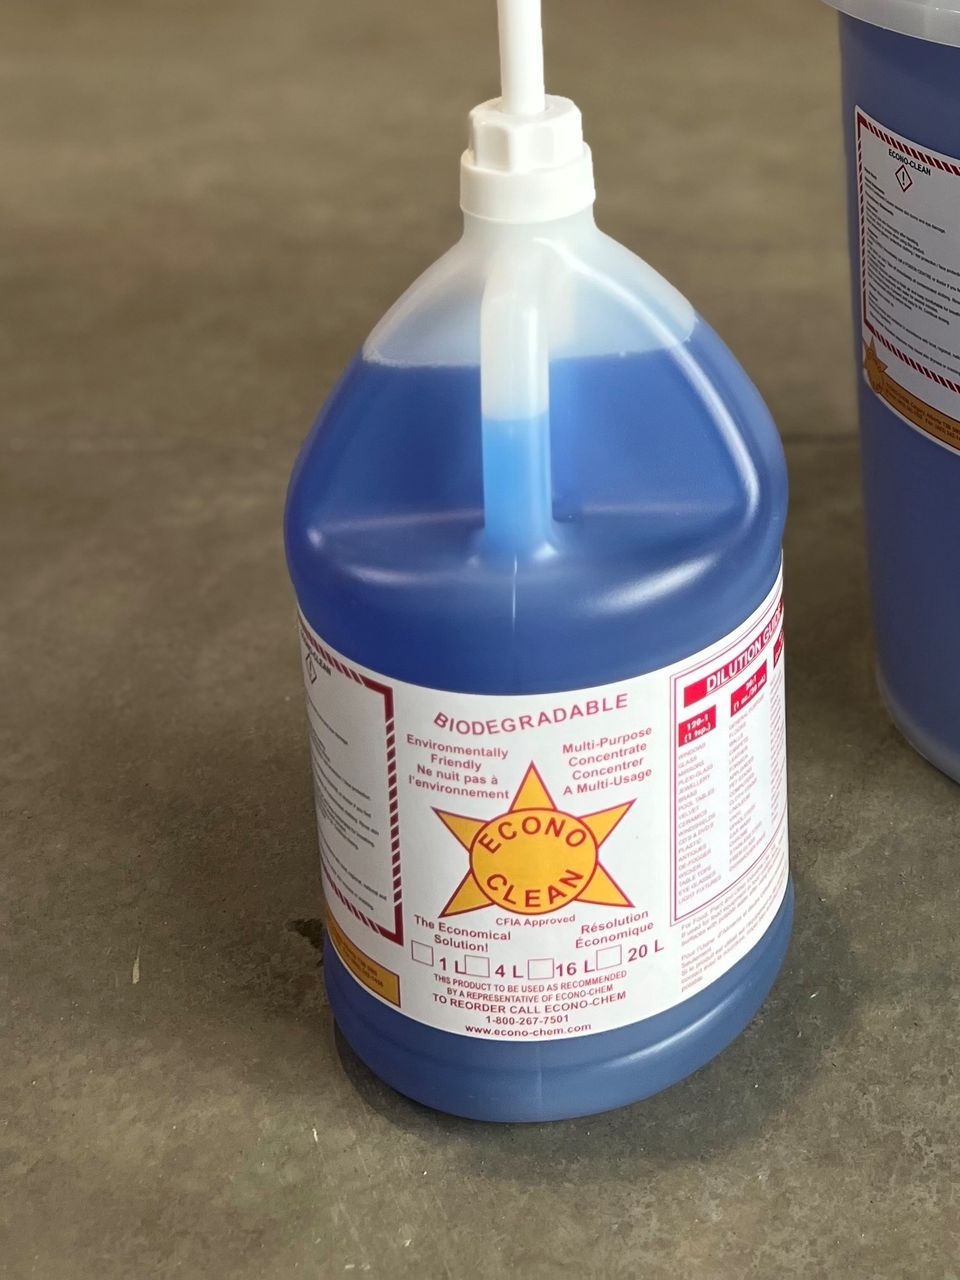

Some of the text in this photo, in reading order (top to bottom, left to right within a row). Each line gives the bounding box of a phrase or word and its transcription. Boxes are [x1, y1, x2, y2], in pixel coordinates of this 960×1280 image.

[888, 148, 931, 176] ECONO-CLEAN
[706, 639, 762, 693] DILUTION
[433, 693, 628, 736] BIODEGRADABLE
[406, 733, 509, 760] Environmentally
[562, 726, 652, 755] Multi-Purpose
[431, 753, 482, 773] Friendly
[568, 742, 648, 767] Concentrate
[417, 763, 498, 788] Ne nuit pas à
[563, 768, 653, 795] A Multi-Usage
[572, 757, 644, 781] Concentrer
[408, 775, 509, 799] l'environnement
[478, 816, 586, 854] ECONO
[486, 869, 584, 908] CLEAN
[414, 914, 511, 941] The Economical
[495, 914, 576, 927] CFIA Approved
[581, 910, 649, 934] Résolution
[434, 934, 488, 952] Solution!
[575, 922, 654, 949] Économique
[439, 939, 664, 978] 1 L 4 L 16 L 20 L
[433, 970, 627, 993] THIS PRODUCT TO BE USED AS RECOMMENDED
[447, 984, 613, 1004] BY A REPRESENTATIVE OF ECONO-CHEM
[432, 991, 626, 1014] TO REORDER CALL ECONO-CHEM
[465, 1023, 592, 1037] www.econo-chem.com
[486, 1014, 569, 1026] 1-800-267-7501
